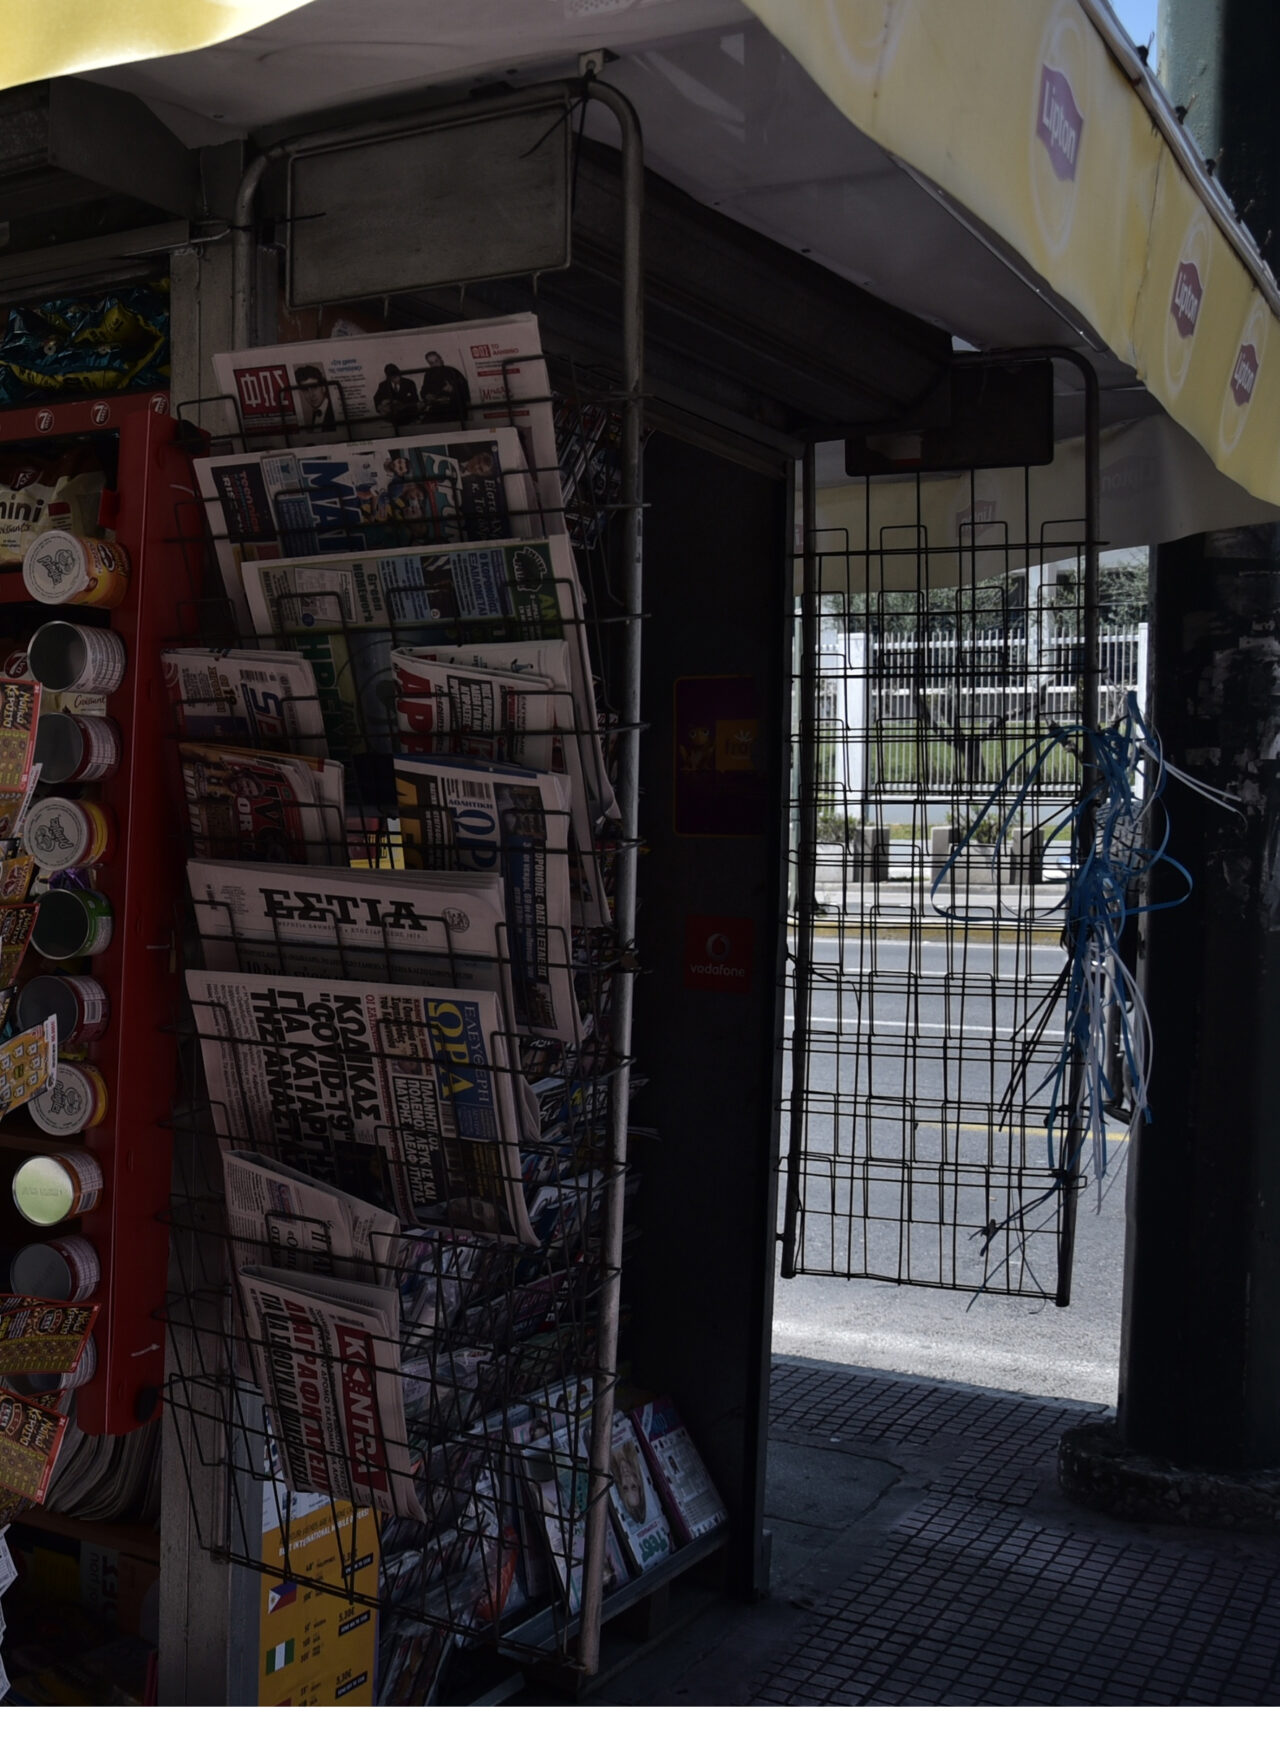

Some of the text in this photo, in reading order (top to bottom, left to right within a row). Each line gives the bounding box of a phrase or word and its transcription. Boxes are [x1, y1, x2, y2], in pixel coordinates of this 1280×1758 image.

[1043, 81, 1076, 165] Lipton
[1175, 272, 1198, 328] Lipton
[239, 370, 291, 408] ΦΩΣ
[259, 888, 428, 931] ΕΣΤΙΑ
[690, 963, 745, 979] vodafone
[249, 988, 285, 1042] ΤΗΣ
[275, 990, 310, 1034] ΓΙΑ
[332, 995, 380, 1121] ΚΩΔΙΚΑΣ
[426, 1002, 473, 1099] ΩΡΑ
[463, 1005, 489, 1103] ΕΛΕΥΘΕΡΗ
[419, 1080, 438, 1152] ΠΛΑΝΗΤΙΟΣ
